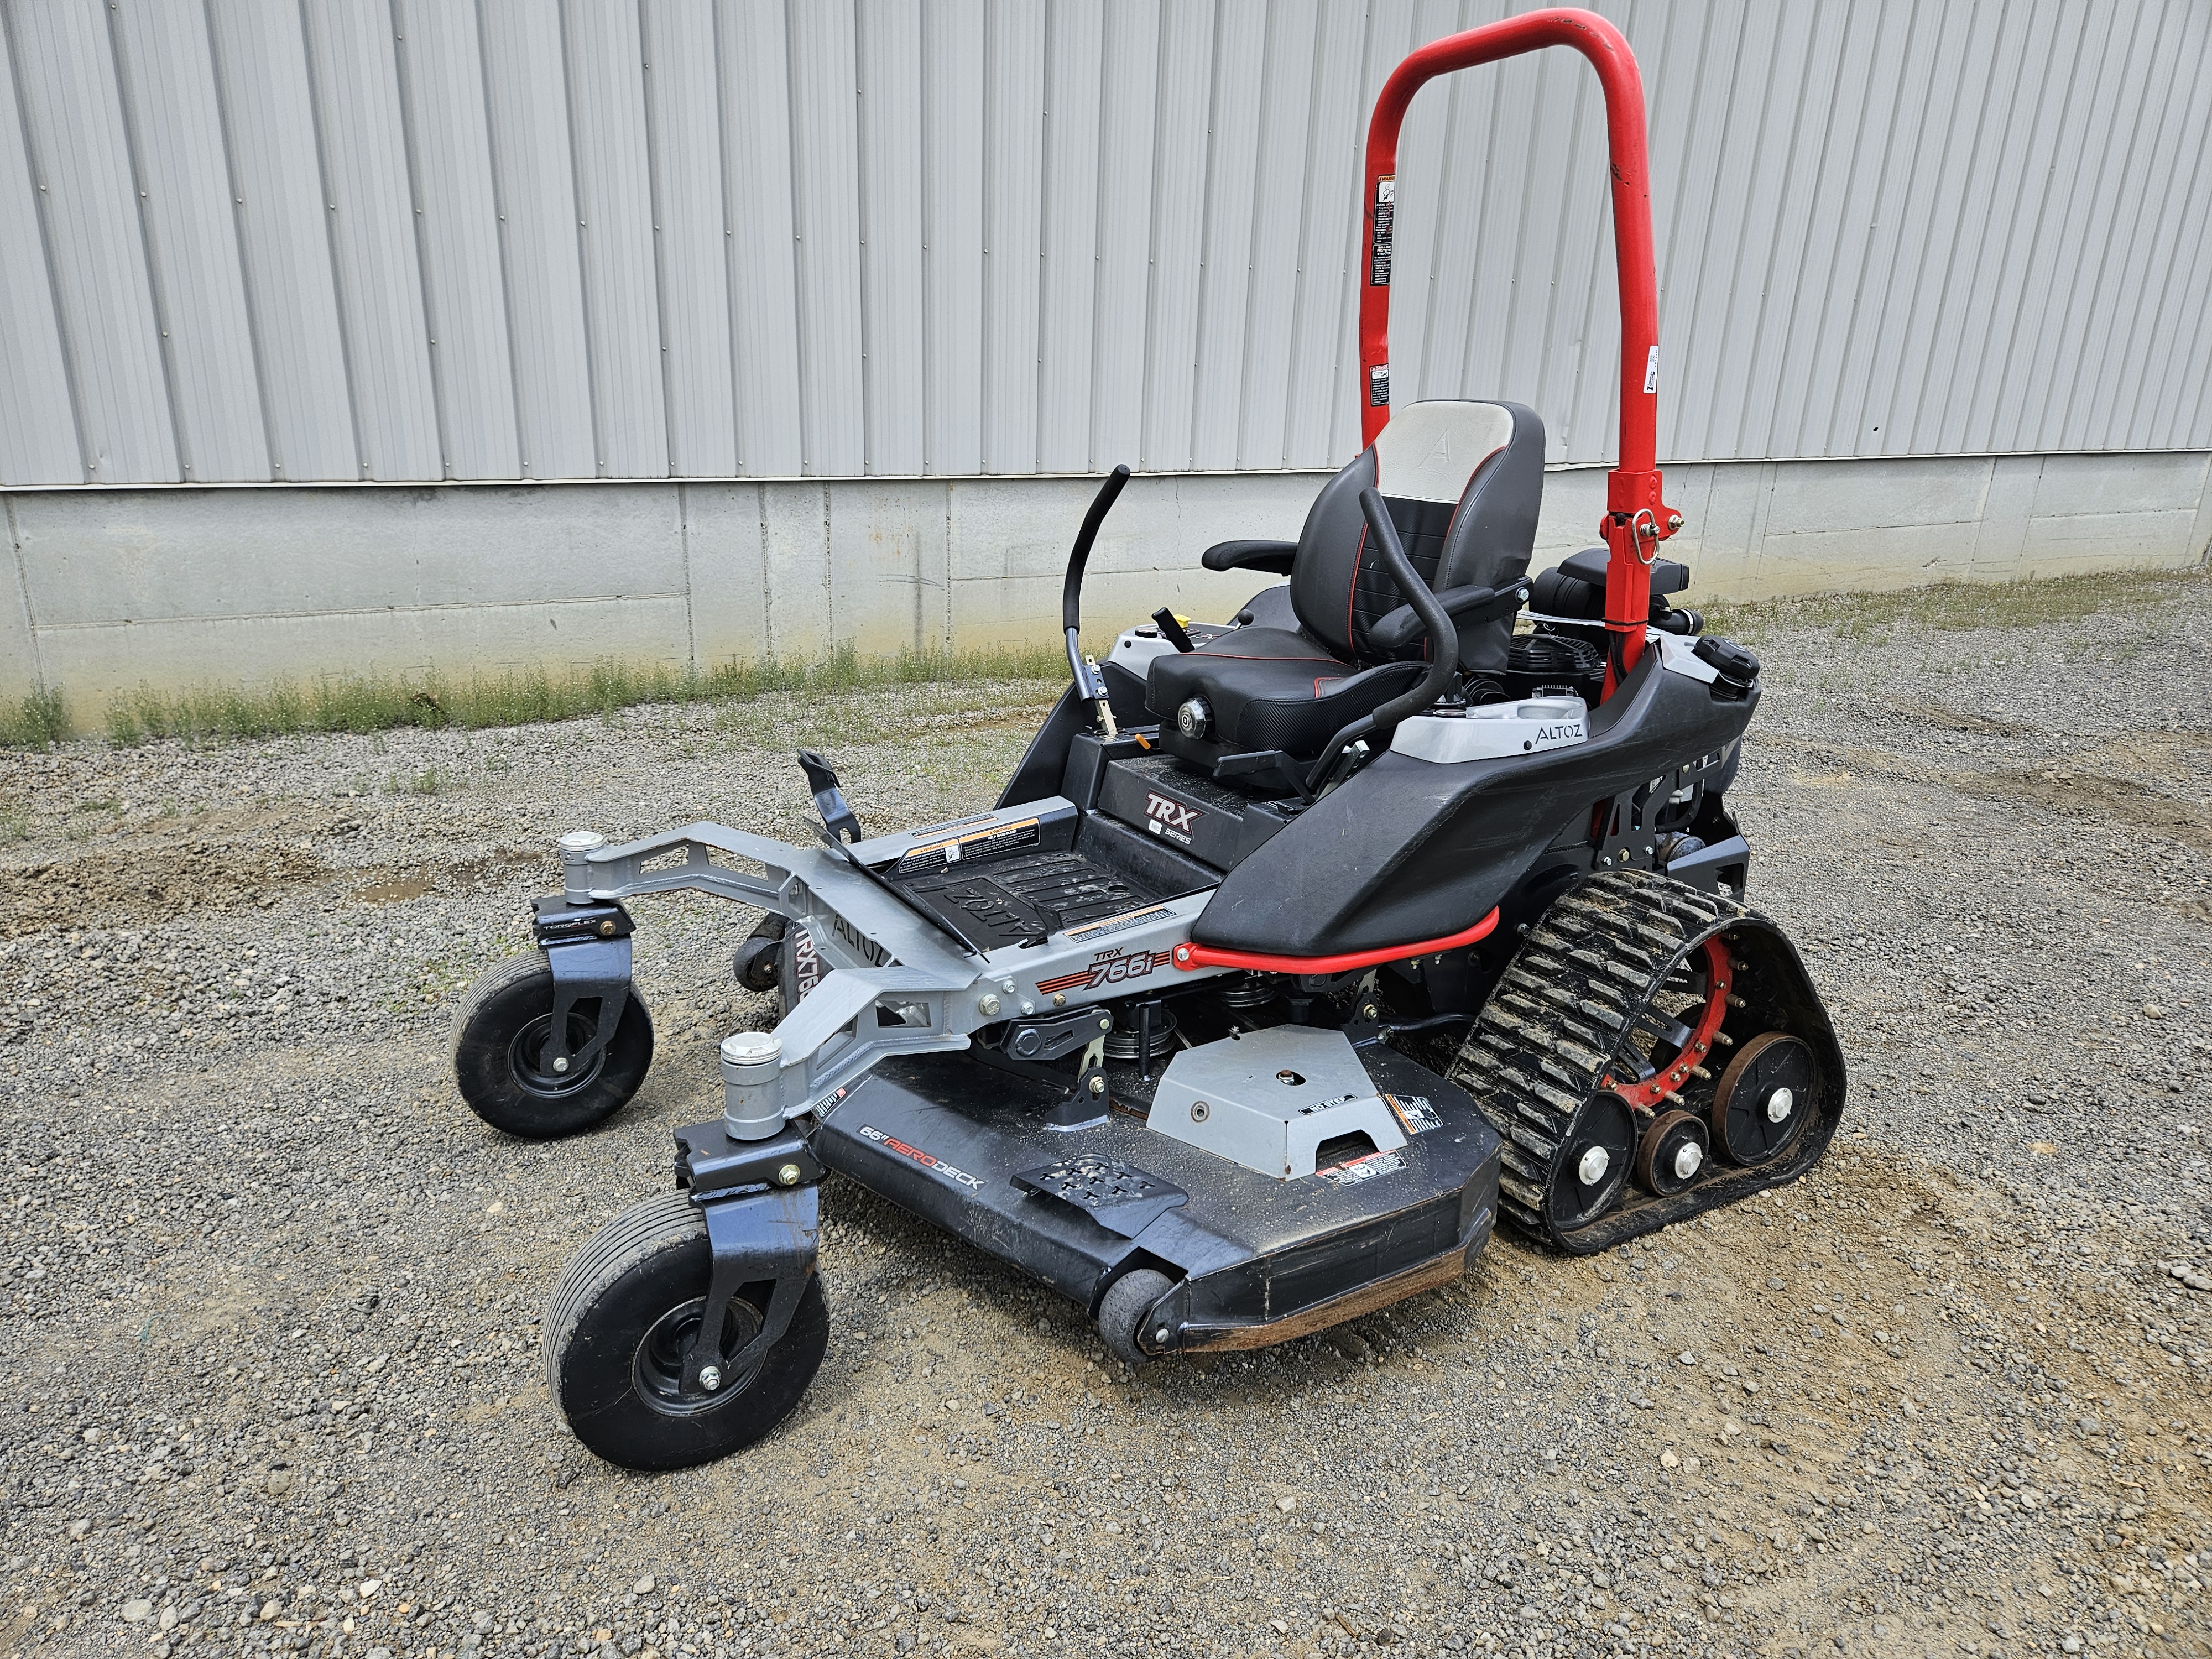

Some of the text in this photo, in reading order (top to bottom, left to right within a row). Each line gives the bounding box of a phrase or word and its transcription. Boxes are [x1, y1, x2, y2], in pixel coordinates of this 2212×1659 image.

[1535, 724, 1583, 745] ALTOZ
[1146, 792, 1199, 833] TRX
[1165, 828, 1192, 845] SERIES
[924, 843, 944, 852] WARNING
[543, 919, 597, 930] TORQFLEX
[1094, 947, 1124, 961] TRX
[1088, 953, 1154, 988] 766i
[1323, 1097, 1345, 1107] STEP
